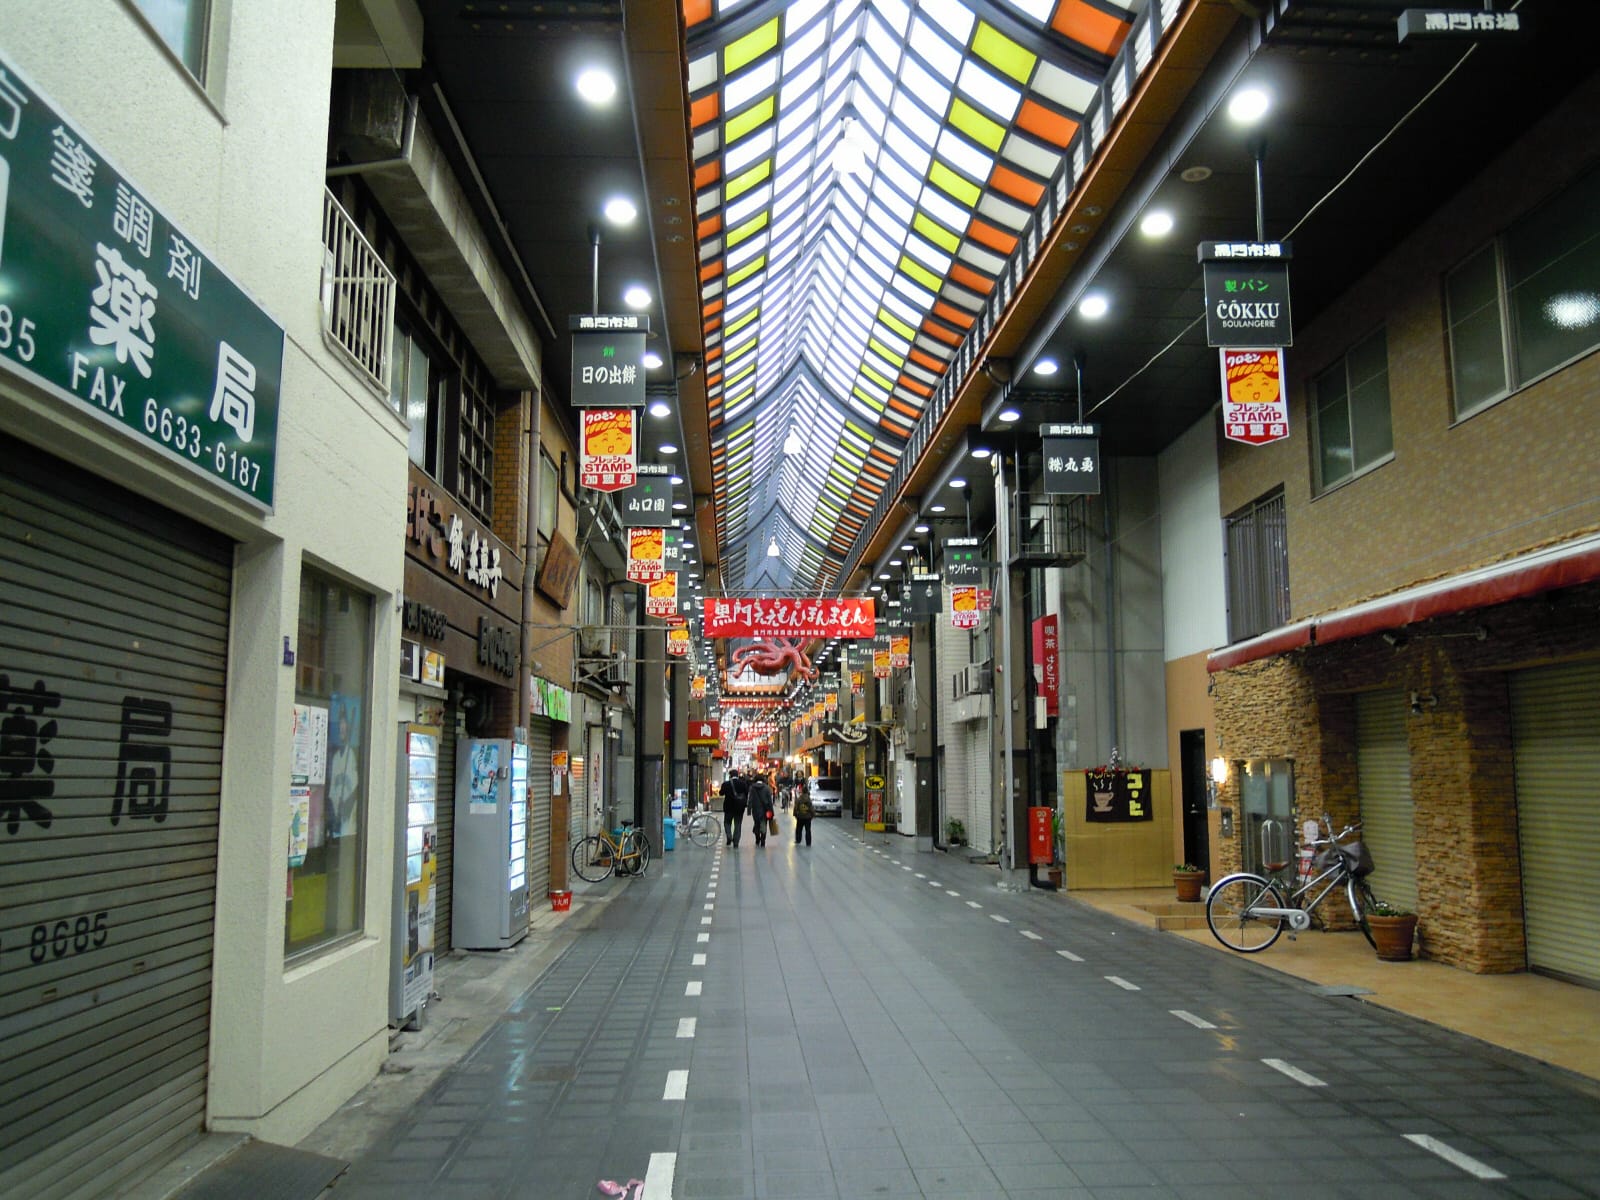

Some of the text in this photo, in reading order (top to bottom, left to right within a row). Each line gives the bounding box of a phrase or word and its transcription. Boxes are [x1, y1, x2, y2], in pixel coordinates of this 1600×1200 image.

[1425, 12, 1520, 31] 黒門市場
[1215, 243, 1281, 257] 黒門市場
[1224, 278, 1270, 293] 製パン
[580, 316, 638, 329] 黒門市場
[1222, 319, 1276, 328] BOULANGERIE
[90, 241, 258, 444] 薬局
[1226, 353, 1261, 367] クロモン
[582, 365, 637, 385] 日の出餅
[1233, 403, 1275, 412] フレッシュ
[70, 351, 261, 493] FAX 6633-6187
[585, 410, 617, 423] クロモン
[1229, 411, 1283, 422] STAMP
[1050, 425, 1094, 435] 黒門市場
[1230, 423, 1284, 436] 加盟店
[588, 455, 627, 464] フレッシュ
[585, 463, 633, 473] STAMP
[585, 474, 633, 485] 加盟店
[629, 498, 665, 512] 山口園
[29, 911, 110, 965] 8685
